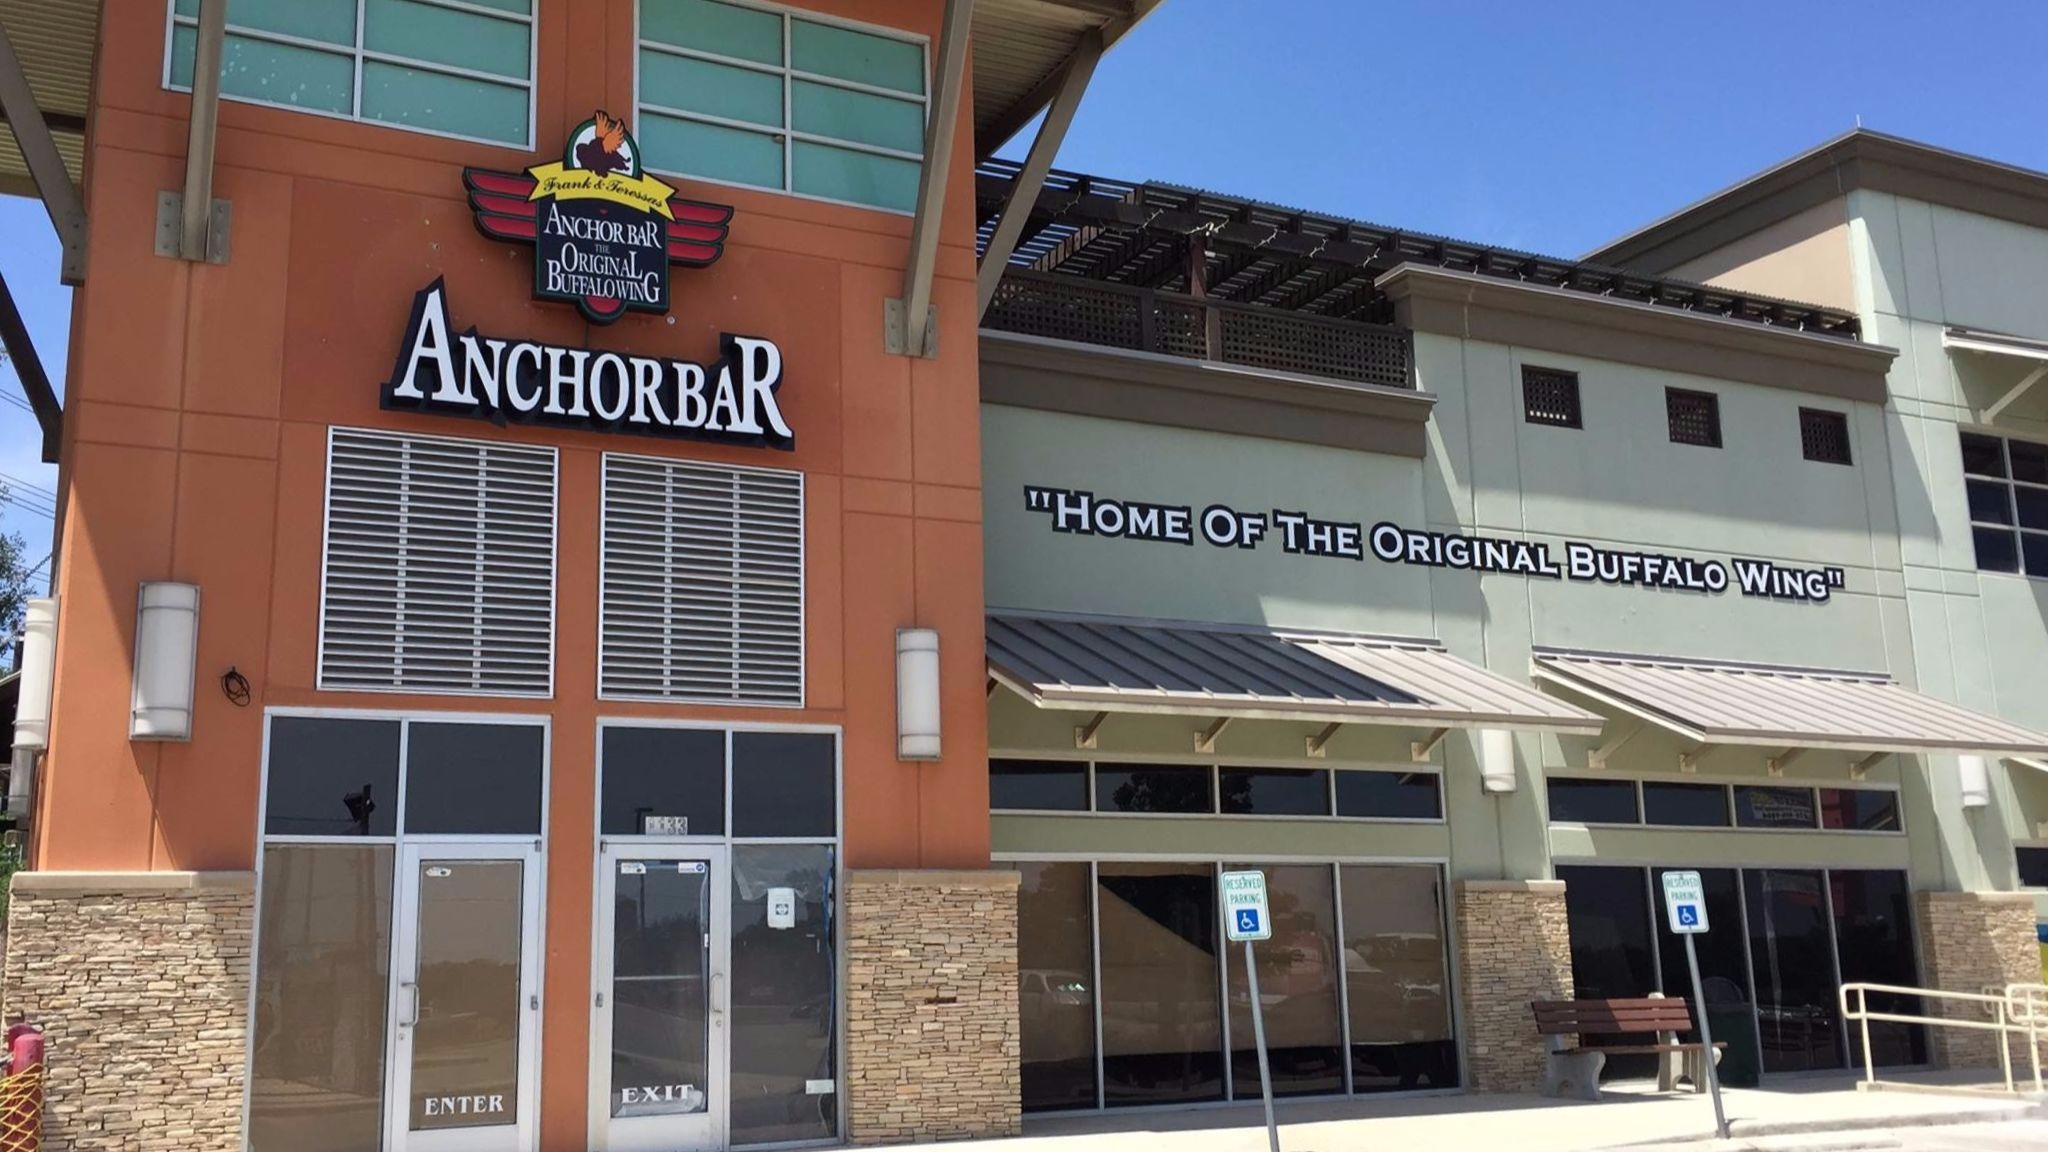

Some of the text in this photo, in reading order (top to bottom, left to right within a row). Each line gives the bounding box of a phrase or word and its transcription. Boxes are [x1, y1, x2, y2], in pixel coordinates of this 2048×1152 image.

[543, 176, 592, 192] Frank
[593, 179, 605, 190] &
[543, 202, 662, 249] ANCHOR BAR
[594, 243, 611, 254] THE
[561, 241, 643, 280] ORIGINAL
[393, 288, 793, 438] ANCHOR BAR
[1204, 508, 1265, 545] OF
[1276, 513, 1360, 556] THE
[1373, 524, 1559, 575] ORIGINAL
[1568, 545, 1727, 591] BUFFALO
[1225, 877, 1262, 890] RESERVED
[1230, 892, 1261, 904] PARKING
[621, 1083, 694, 1104] EXIT
[424, 1094, 504, 1116] ENTER
